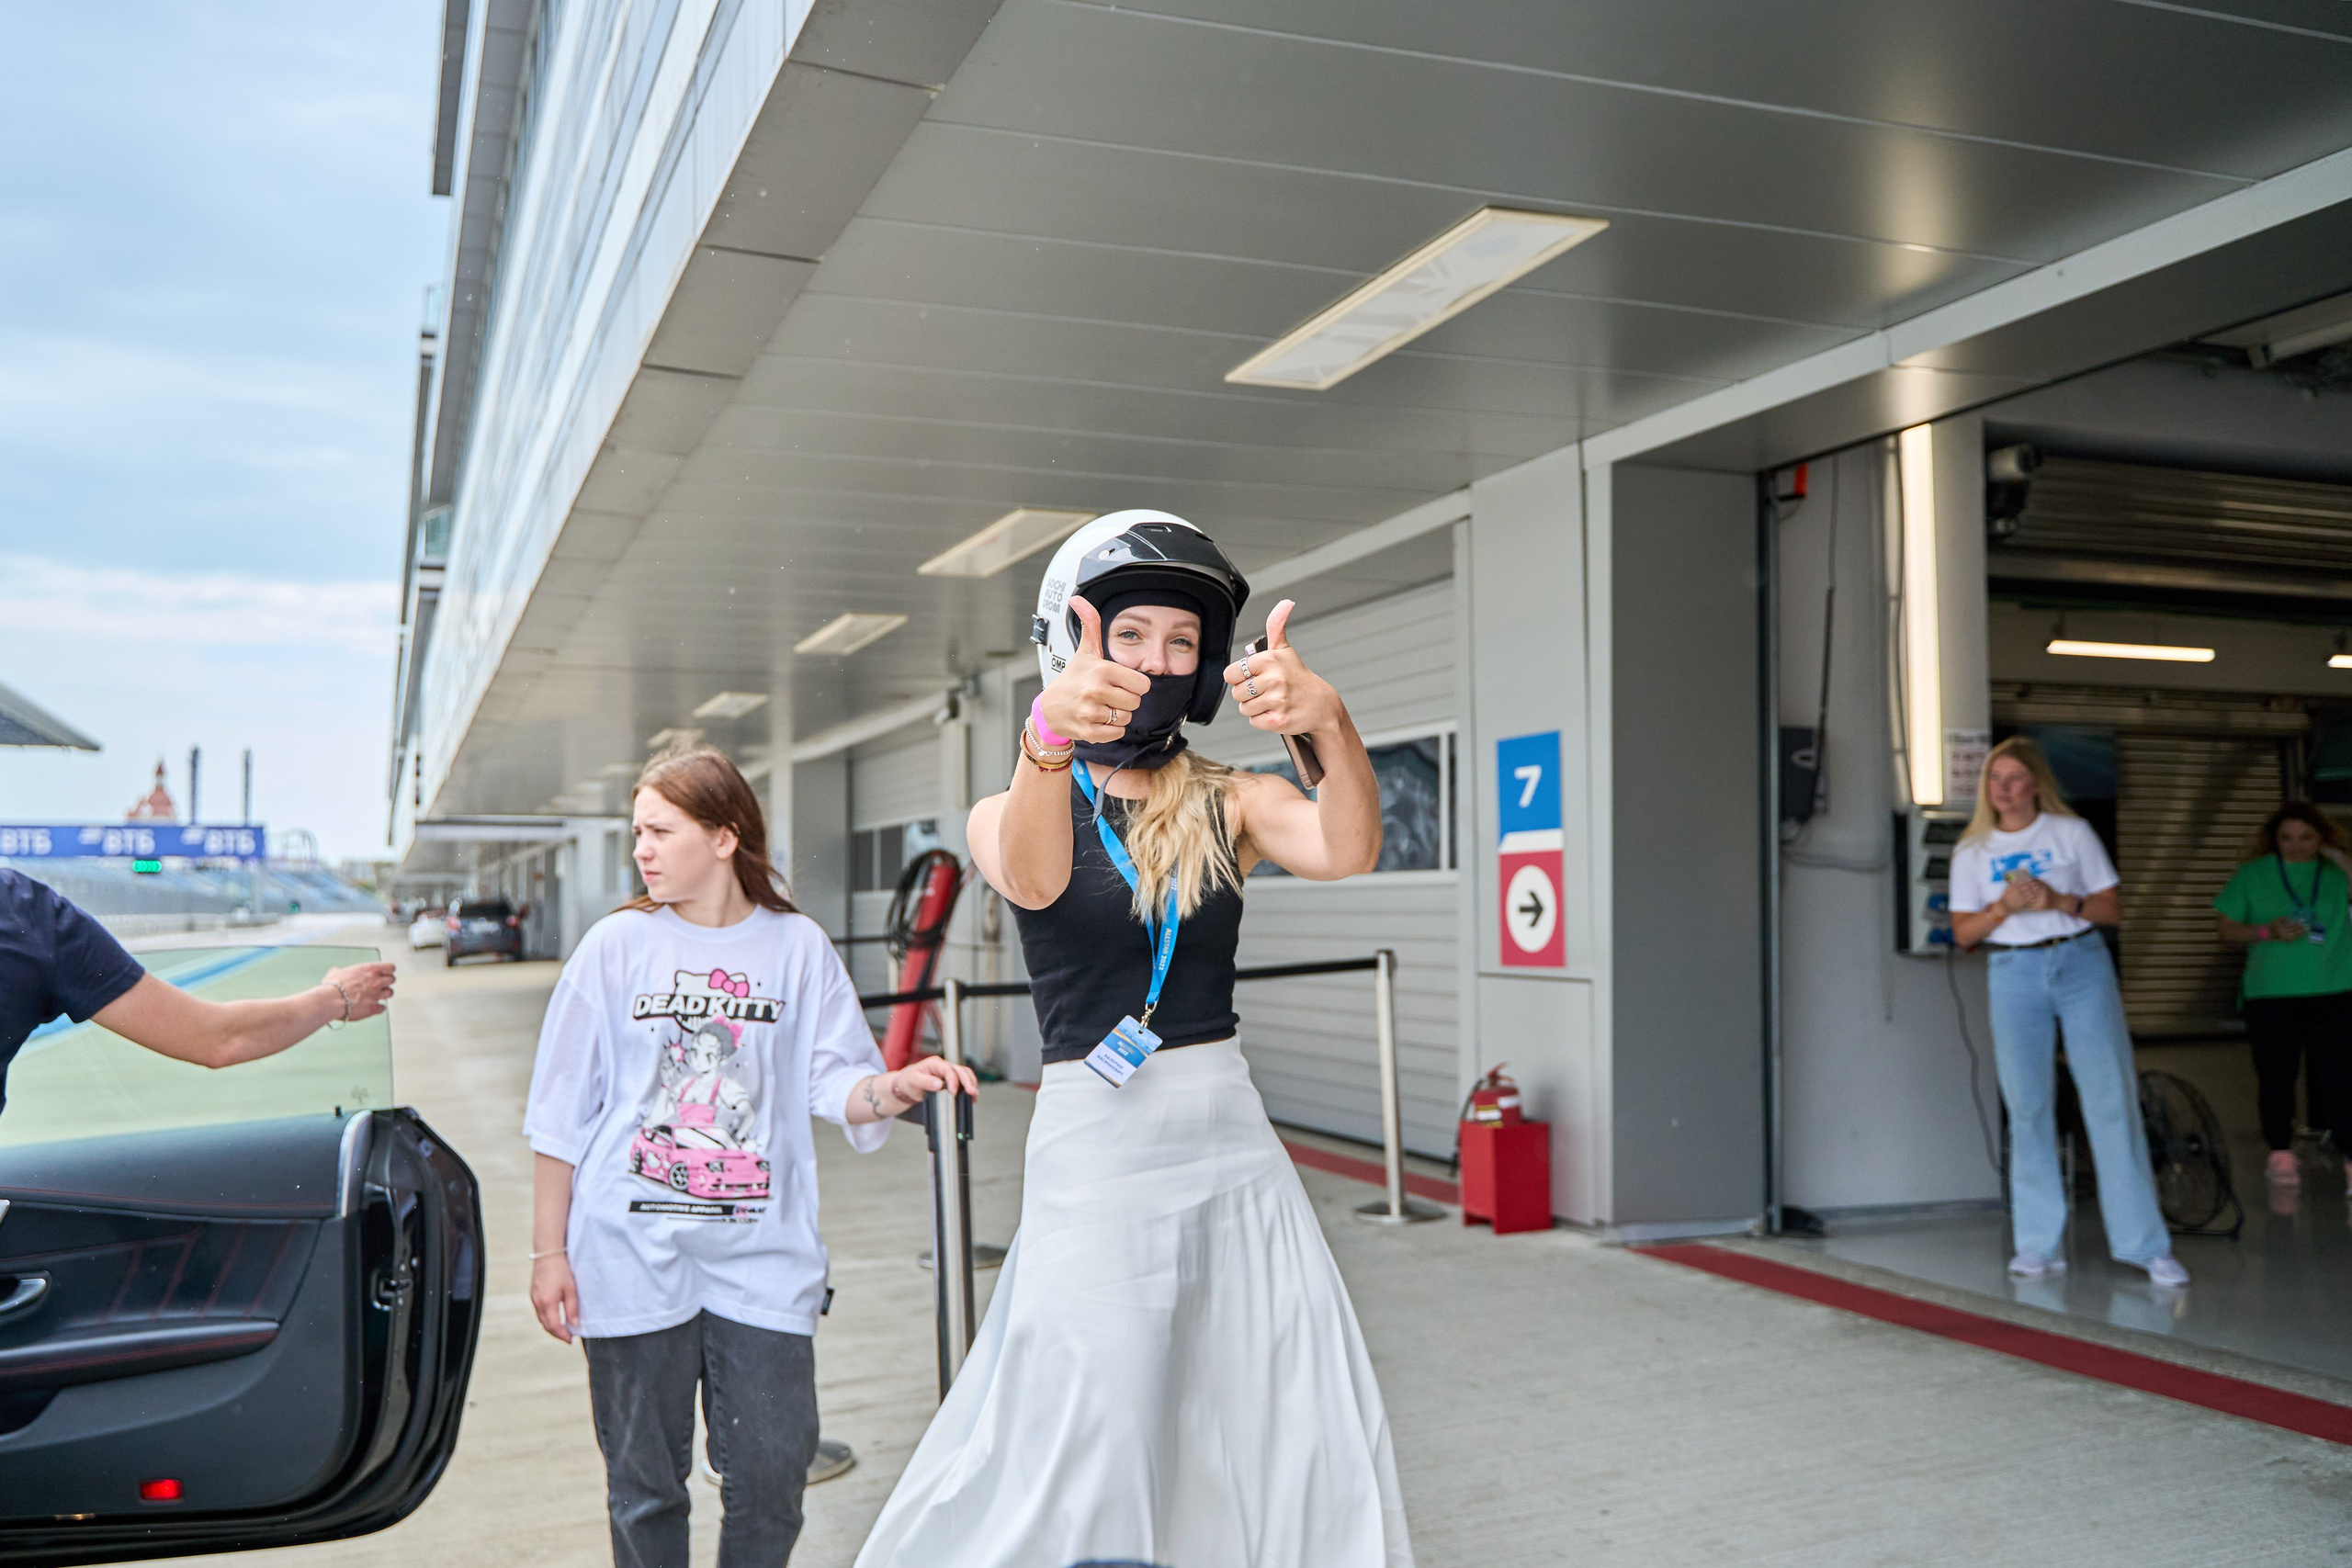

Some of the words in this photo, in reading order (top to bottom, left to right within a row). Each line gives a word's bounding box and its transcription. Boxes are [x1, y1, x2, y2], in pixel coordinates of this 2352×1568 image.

[1046, 577, 1067, 592] SOCHI
[1045, 589, 1063, 603] AUTO
[1043, 599, 1061, 614] DROM
[1051, 657, 1066, 671] OMP
[1513, 764, 1543, 808] 7
[1162, 928, 1172, 954] ALLSTAR
[1159, 955, 1168, 970] 2022
[634, 994, 707, 1019] DEAD
[707, 996, 786, 1021] KITTY
